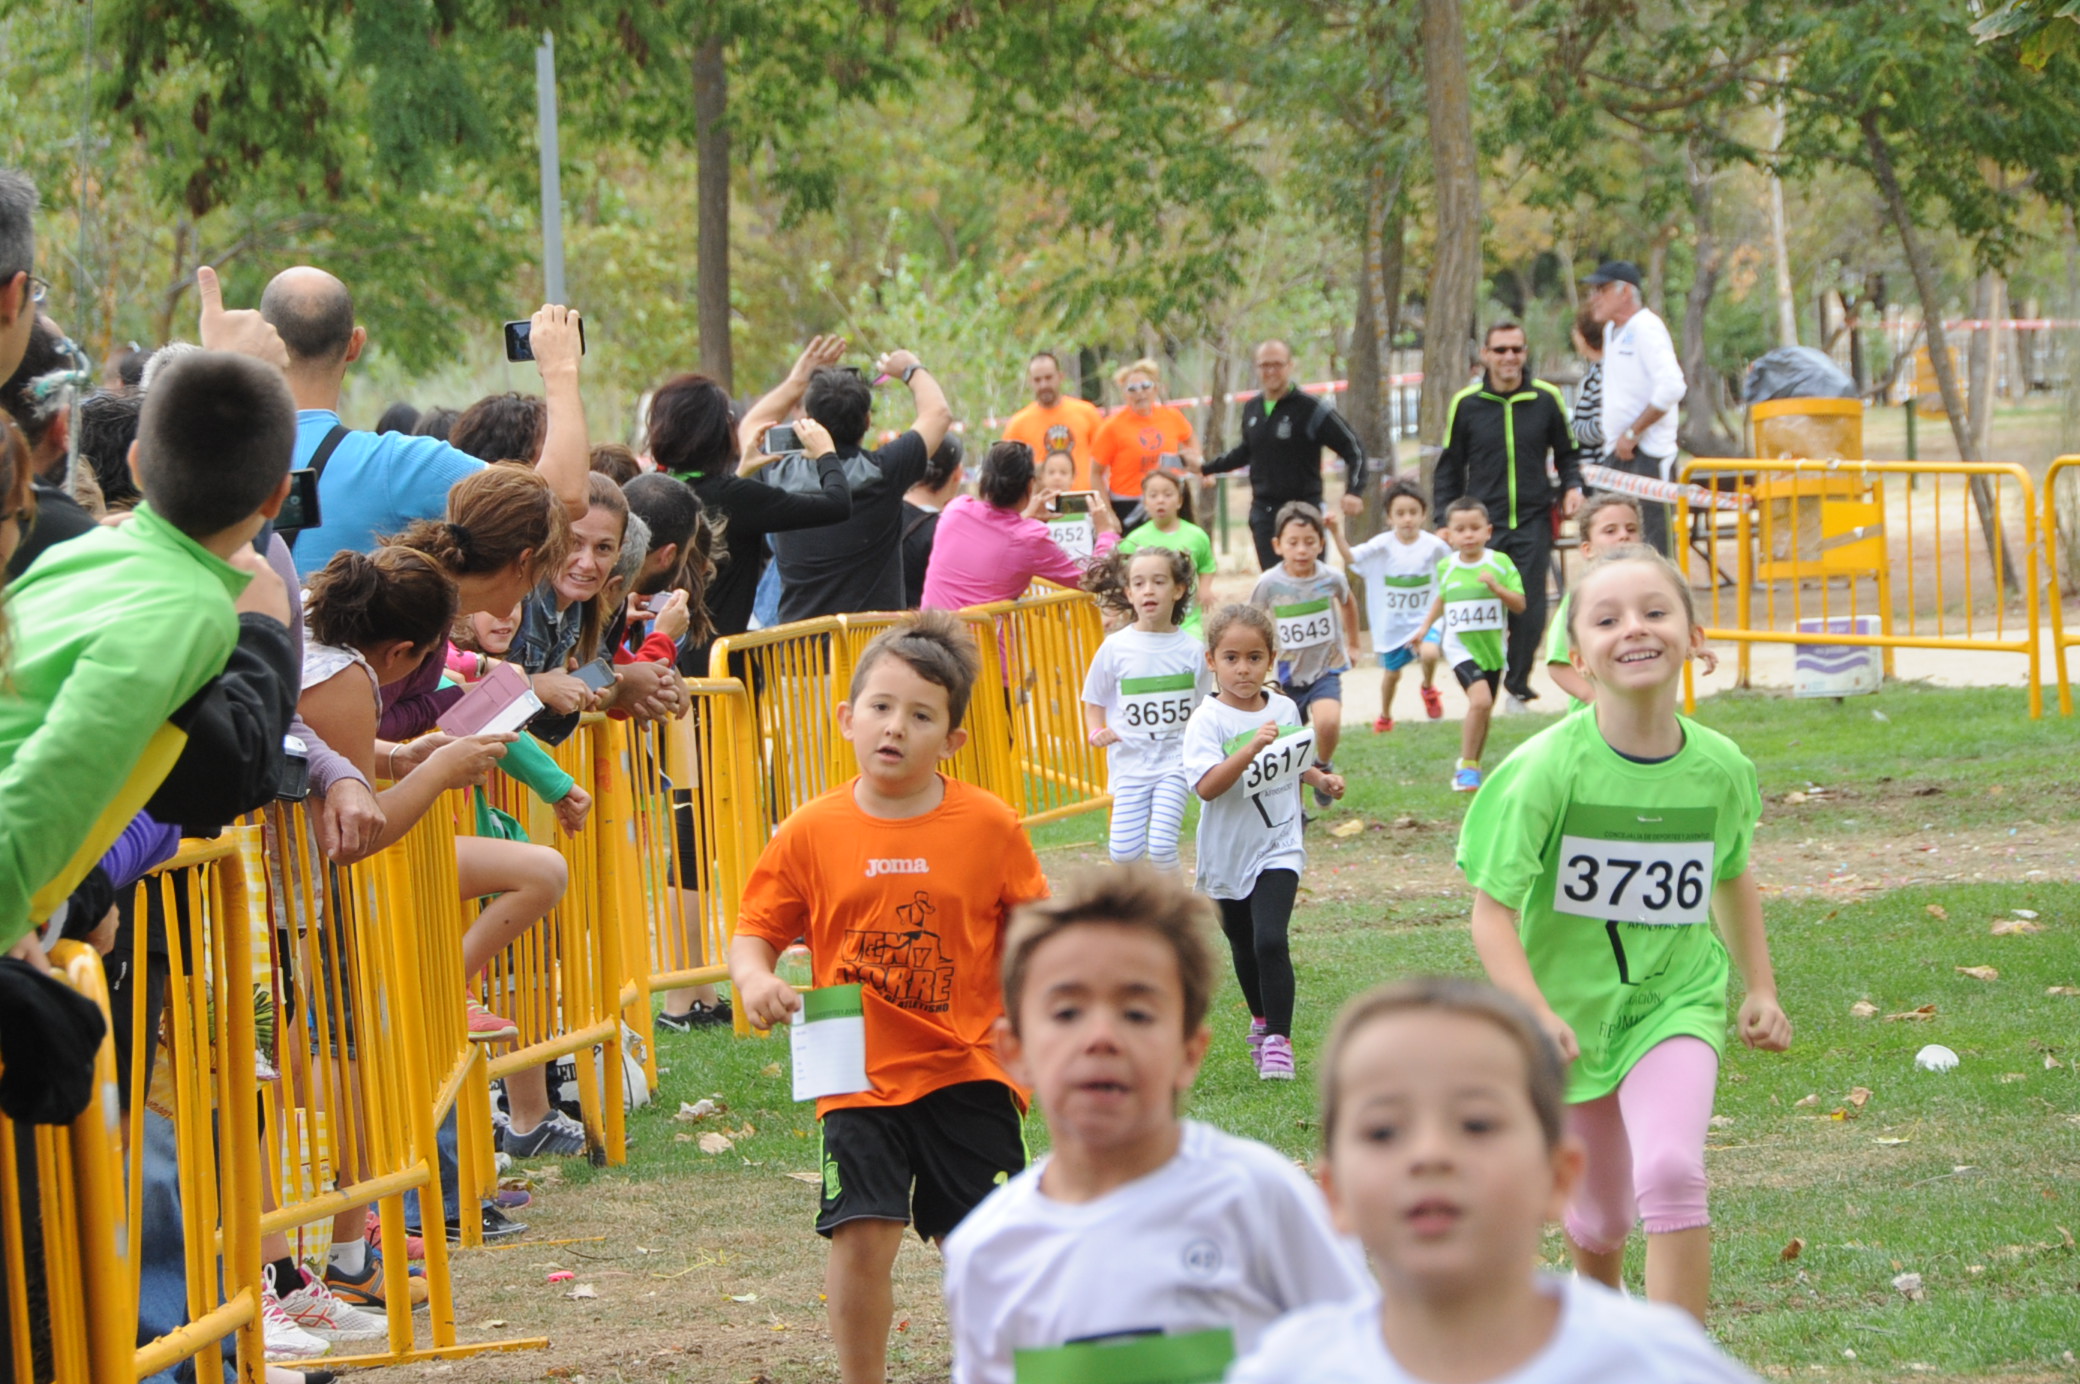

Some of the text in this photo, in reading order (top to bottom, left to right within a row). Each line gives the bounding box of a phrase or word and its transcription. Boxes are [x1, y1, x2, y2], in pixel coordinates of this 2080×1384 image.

[1048, 526, 1084, 544] 652
[1387, 590, 1430, 609] 3707
[1449, 606, 1498, 627] 3444
[1280, 617, 1331, 644] 3643
[1126, 698, 1191, 727] 3655
[1247, 739, 1312, 789] 3617
[1564, 855, 1704, 910] 3736
